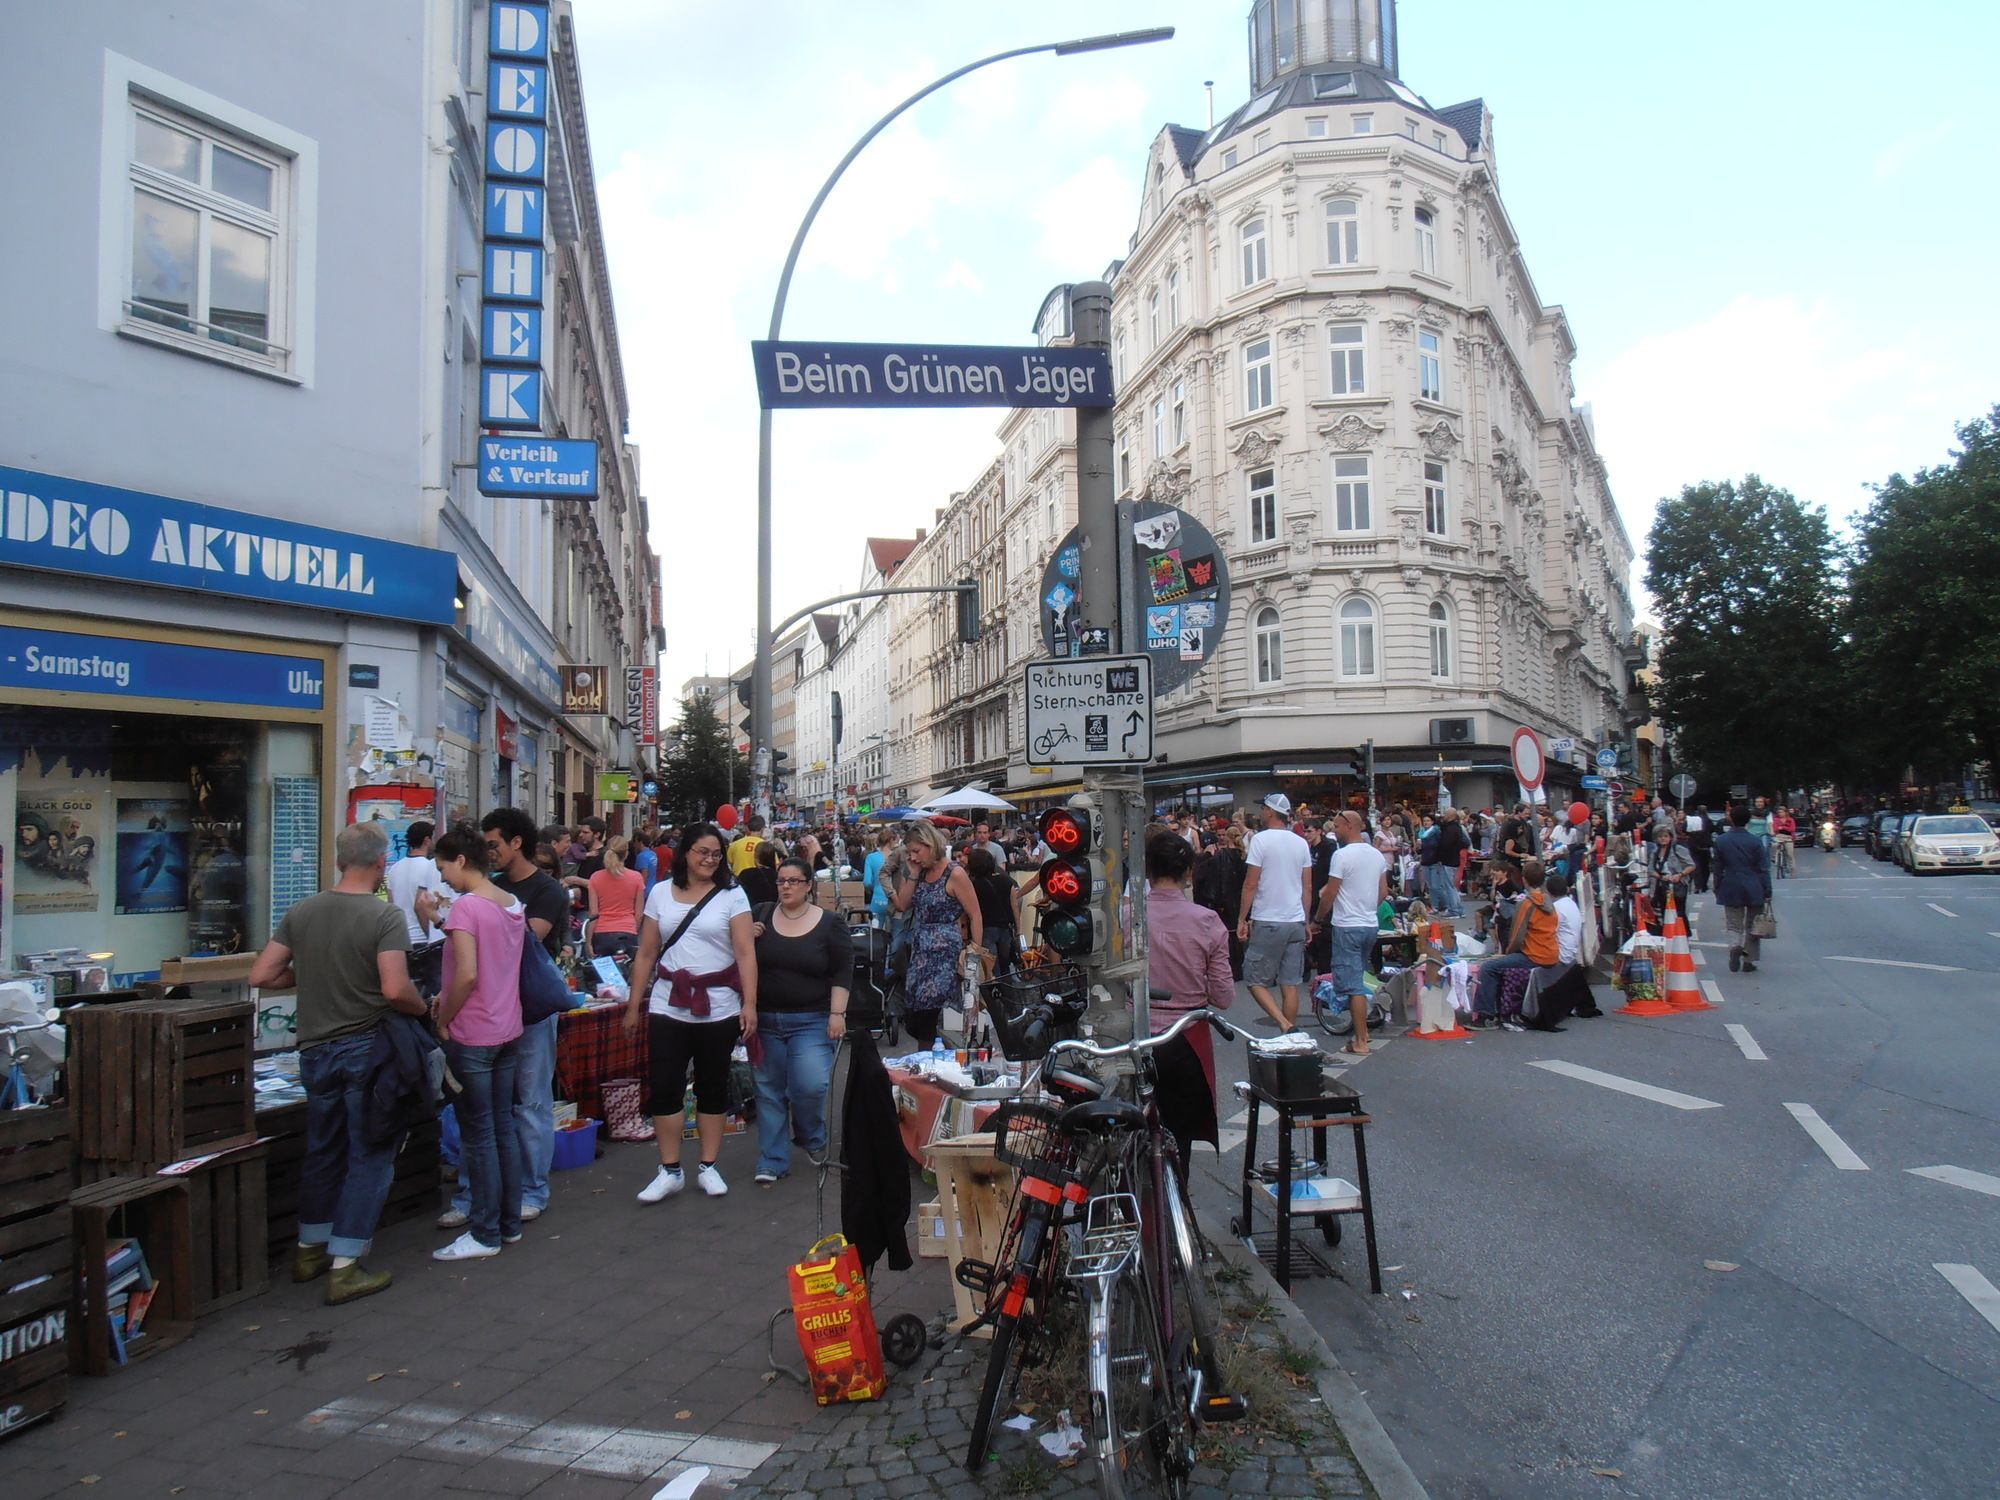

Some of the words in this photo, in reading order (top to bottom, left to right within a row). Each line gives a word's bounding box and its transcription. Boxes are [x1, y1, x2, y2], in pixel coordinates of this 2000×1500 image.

[775, 351, 872, 394] Beim
[884, 353, 1004, 395] Grünen
[1015, 356, 1095, 403] Jäger
[485, 443, 558, 462] Verleih
[487, 466, 504, 482] &
[509, 467, 590, 486] Verkauf
[0, 489, 130, 556] DEO
[151, 518, 374, 596] AKTUELL
[1149, 638, 1178, 648] WHO
[26, 646, 130, 687] Samstag
[288, 670, 323, 695] Uhr
[1033, 671, 1103, 690] Richtung
[1110, 671, 1135, 689] WE
[643, 676, 654, 736] Büromarkt
[1034, 691, 1144, 710] Sternschanze
[20, 801, 57, 810] BLACK
[62, 801, 92, 810] GOLD
[745, 842, 755, 852] 6
[0, 1311, 66, 1362] TION
